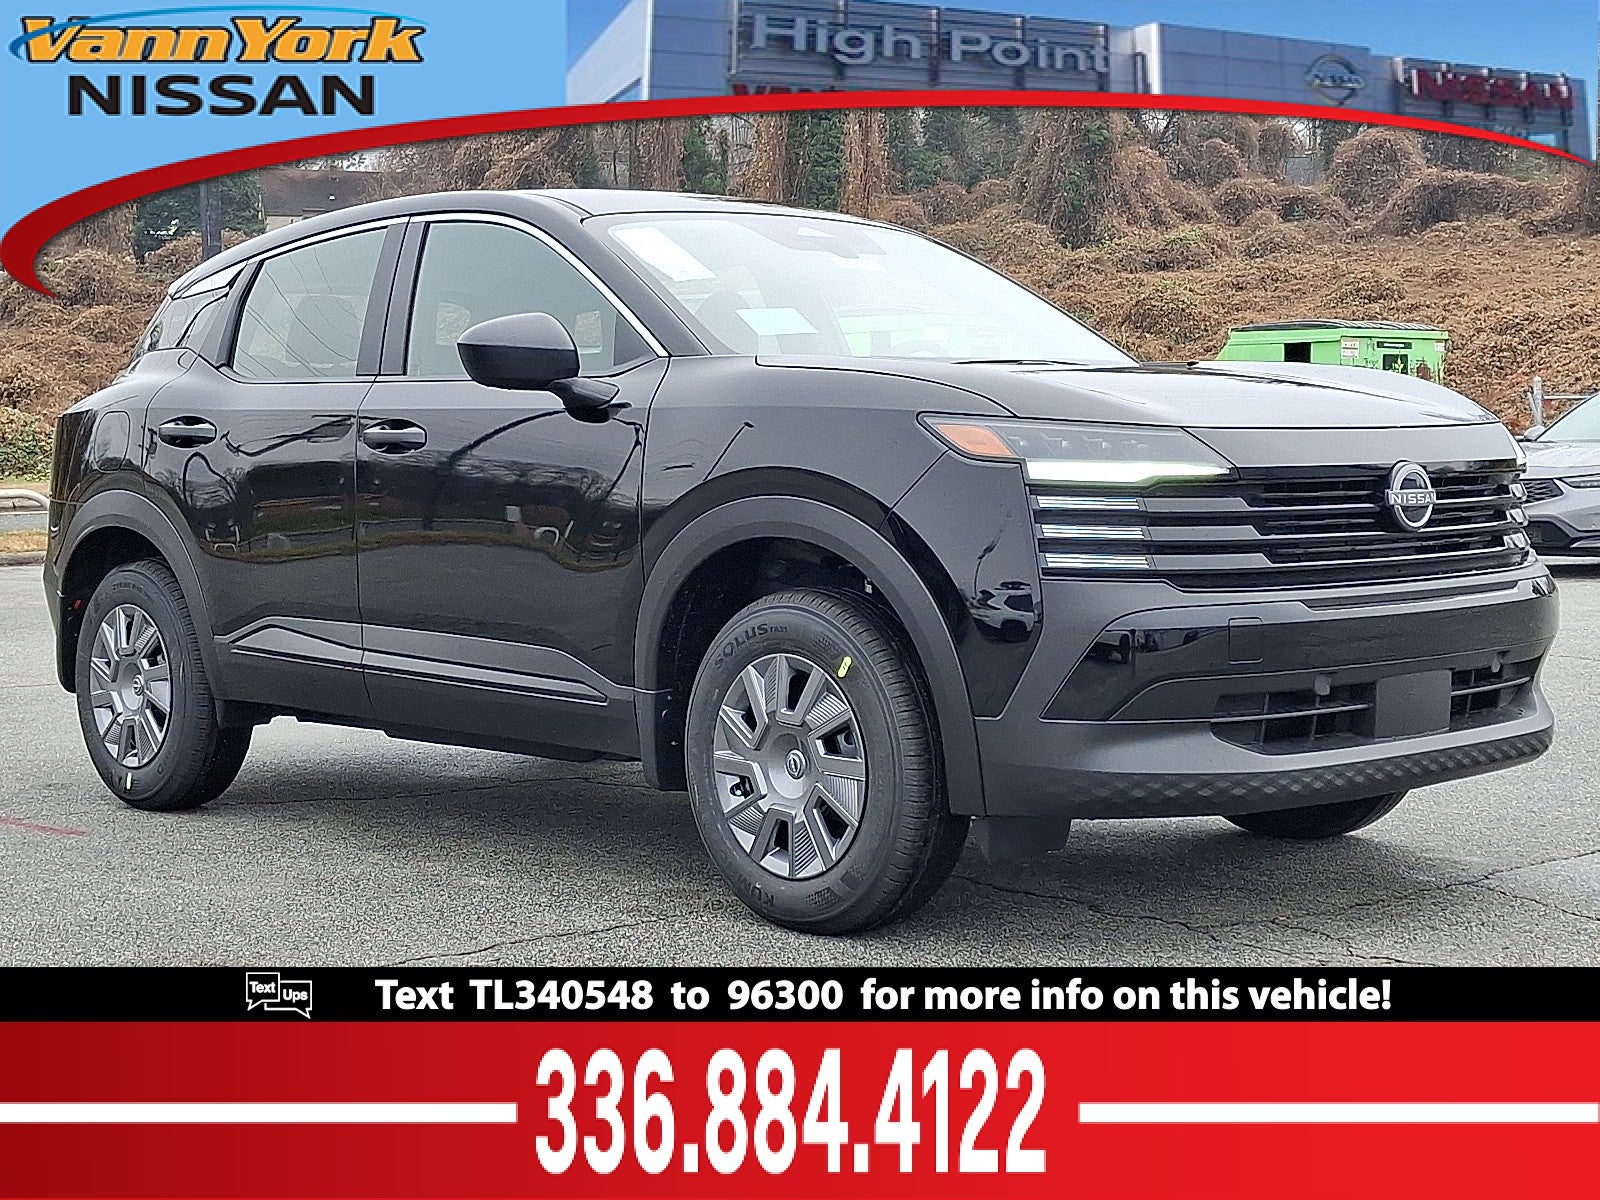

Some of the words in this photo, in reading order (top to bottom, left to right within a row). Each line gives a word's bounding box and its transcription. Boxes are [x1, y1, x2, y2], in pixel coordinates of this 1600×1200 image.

[750, 13, 922, 66] High
[948, 28, 1110, 73] Point
[1390, 492, 1436, 504] NISSAN
[714, 623, 768, 670] SOLUS
